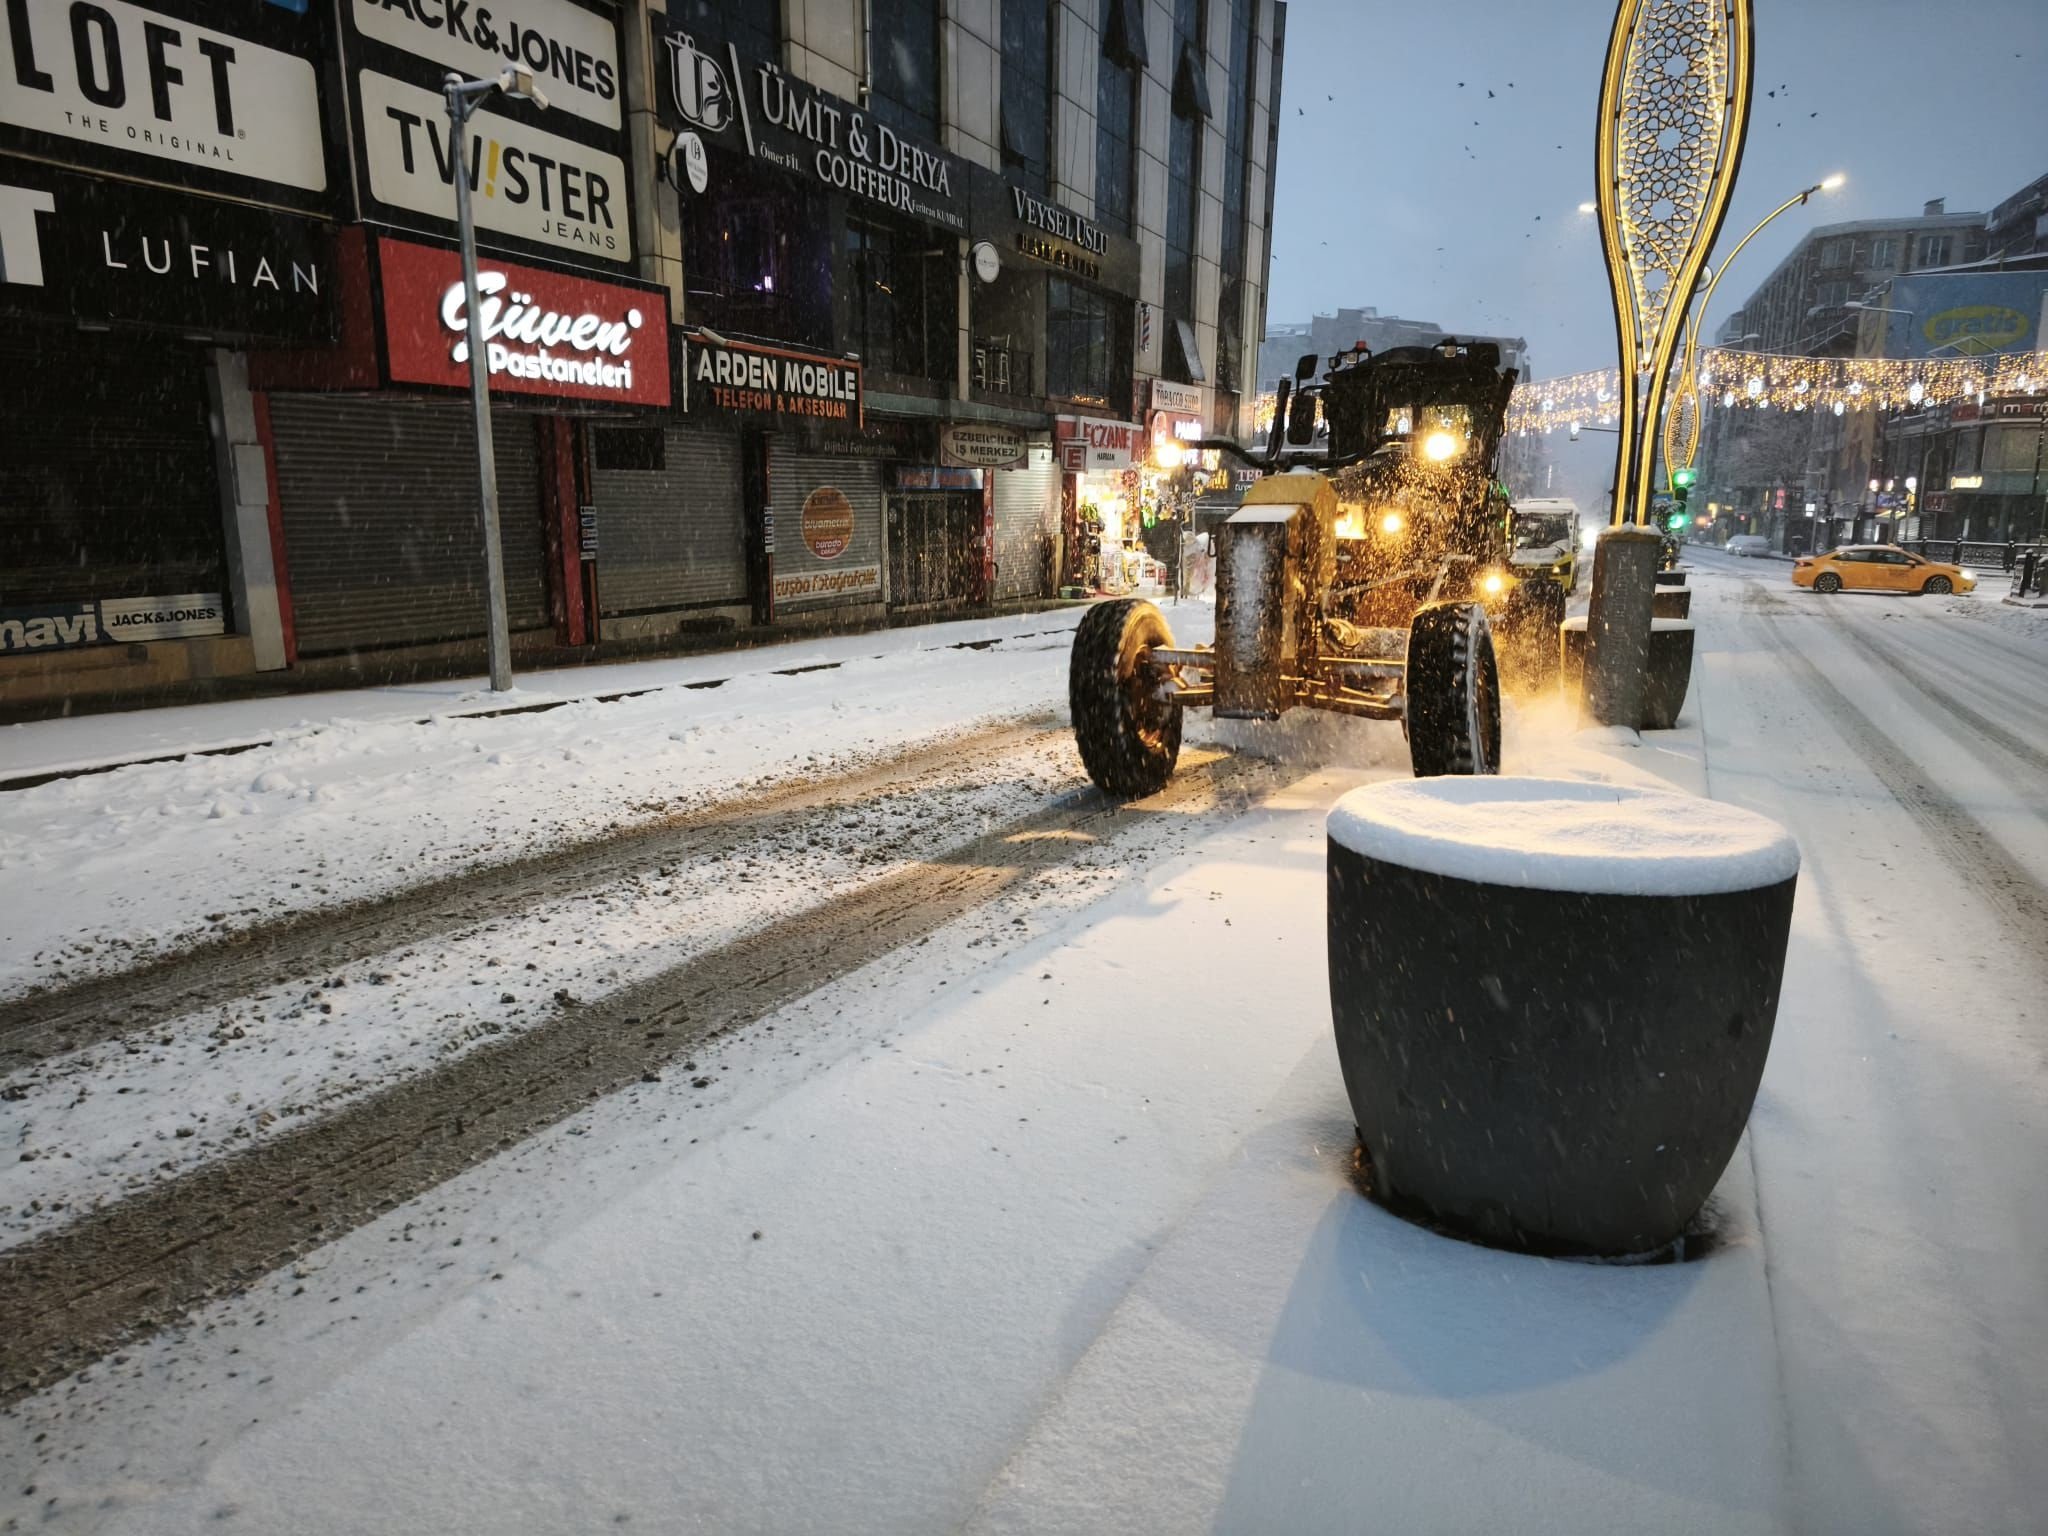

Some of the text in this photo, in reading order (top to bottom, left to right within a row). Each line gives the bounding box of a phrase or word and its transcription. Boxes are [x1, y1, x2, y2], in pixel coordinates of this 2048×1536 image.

[5, 0, 236, 137] LOFT
[365, 0, 616, 100] CK&JONES
[65, 111, 234, 161] THE ORIGINAL
[849, 113, 873, 163] &
[878, 124, 952, 197] DERYA
[816, 150, 915, 214] COIFFEUR
[542, 220, 616, 250] JEANS
[1012, 186, 1110, 257] VEYSEL USLU
[102, 231, 320, 296] LUFIAN
[441, 271, 633, 363] Güven
[486, 343, 632, 389] Pastaneleri
[697, 348, 778, 391] ARDEN
[713, 387, 847, 419] TELEFON & AKSESUAR
[1156, 389, 1184, 407] TOBACCO
[956, 442, 1019, 457] İŞ MERKEZİ
[1068, 448, 1082, 468] E
[111, 607, 217, 627] JACK&JONES
